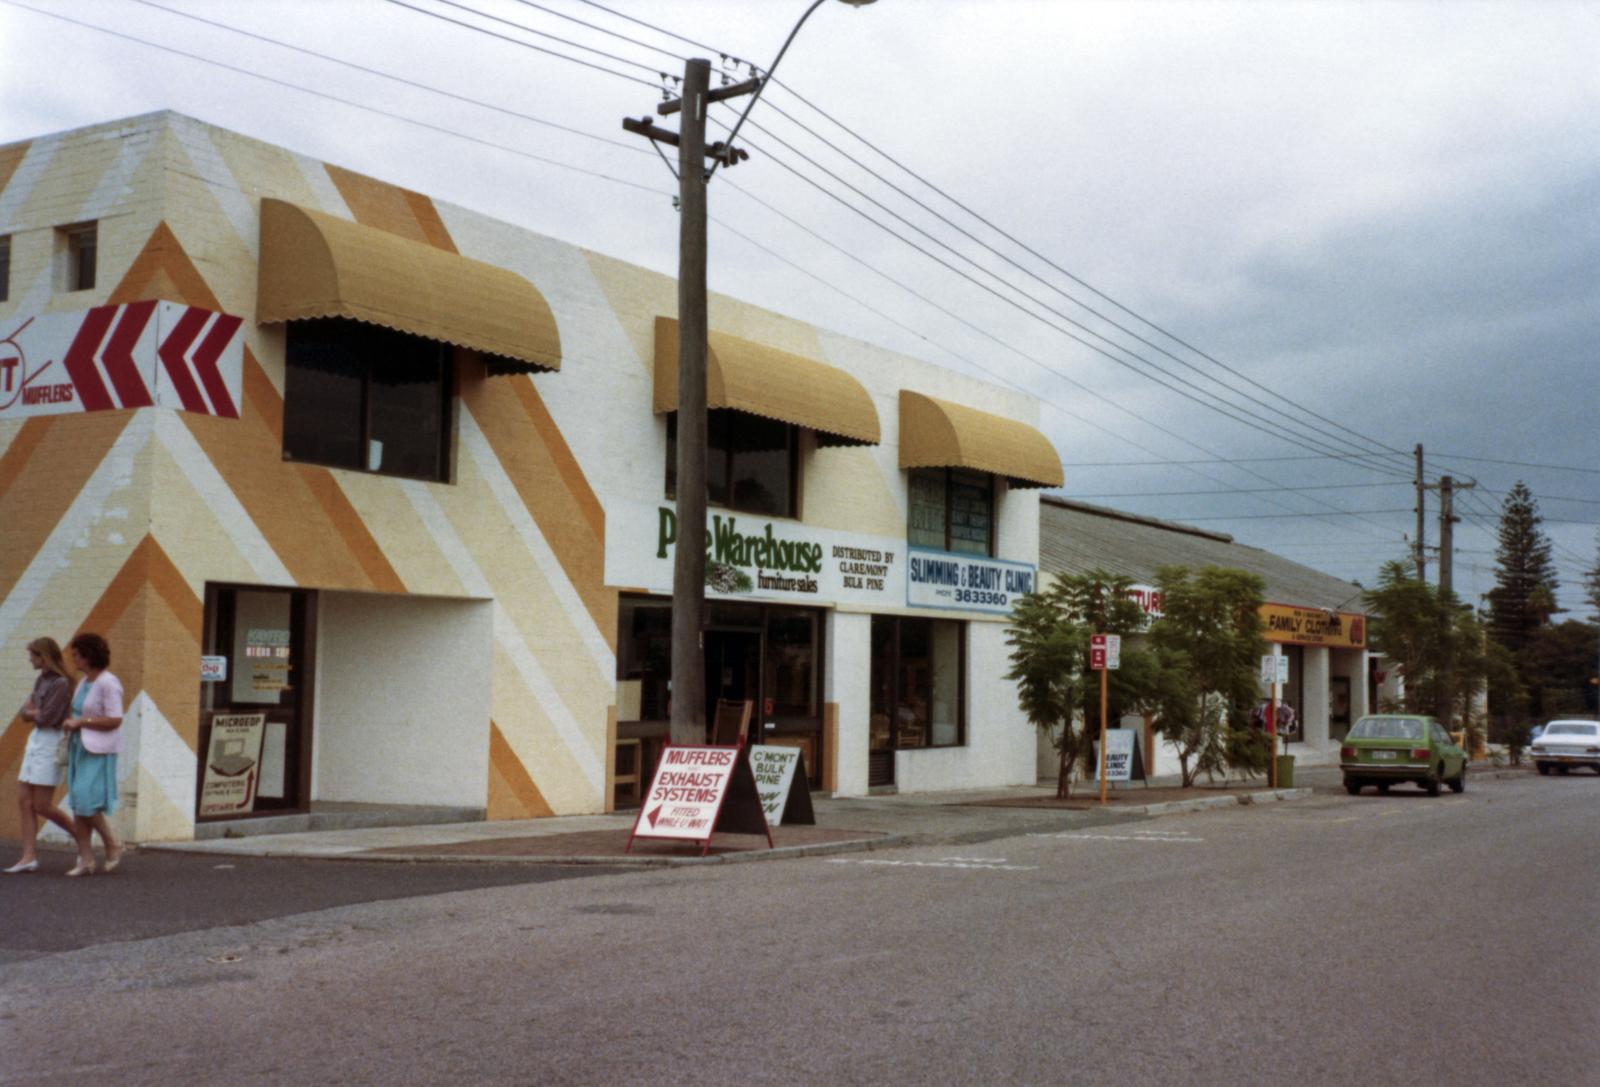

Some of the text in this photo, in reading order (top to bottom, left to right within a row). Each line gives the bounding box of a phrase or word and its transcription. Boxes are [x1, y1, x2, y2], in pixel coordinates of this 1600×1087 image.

[22, 384, 73, 405] MUFFLERS
[657, 506, 823, 573] Pe Warehouse
[832, 545, 895, 564] DISTRIBUTED BY
[839, 563, 888, 577] CLAREMONT
[911, 557, 1032, 594] SLIMMING & BEAUTY CLINIC
[757, 570, 818, 593] furniture sales
[843, 576, 884, 591] BULK PINE
[954, 588, 1008, 606] 3833360
[1269, 614, 1302, 633] FAMILY
[666, 751, 732, 765] MUFFLERS
[1105, 761, 1126, 769] LINIC
[1106, 753, 1128, 761] EAUTY
[756, 763, 786, 774] BULK
[658, 771, 724, 787] EXHAUST
[756, 774, 781, 785] PINE
[652, 787, 718, 803] SYSTEMS
[670, 807, 701, 817] FITTED
